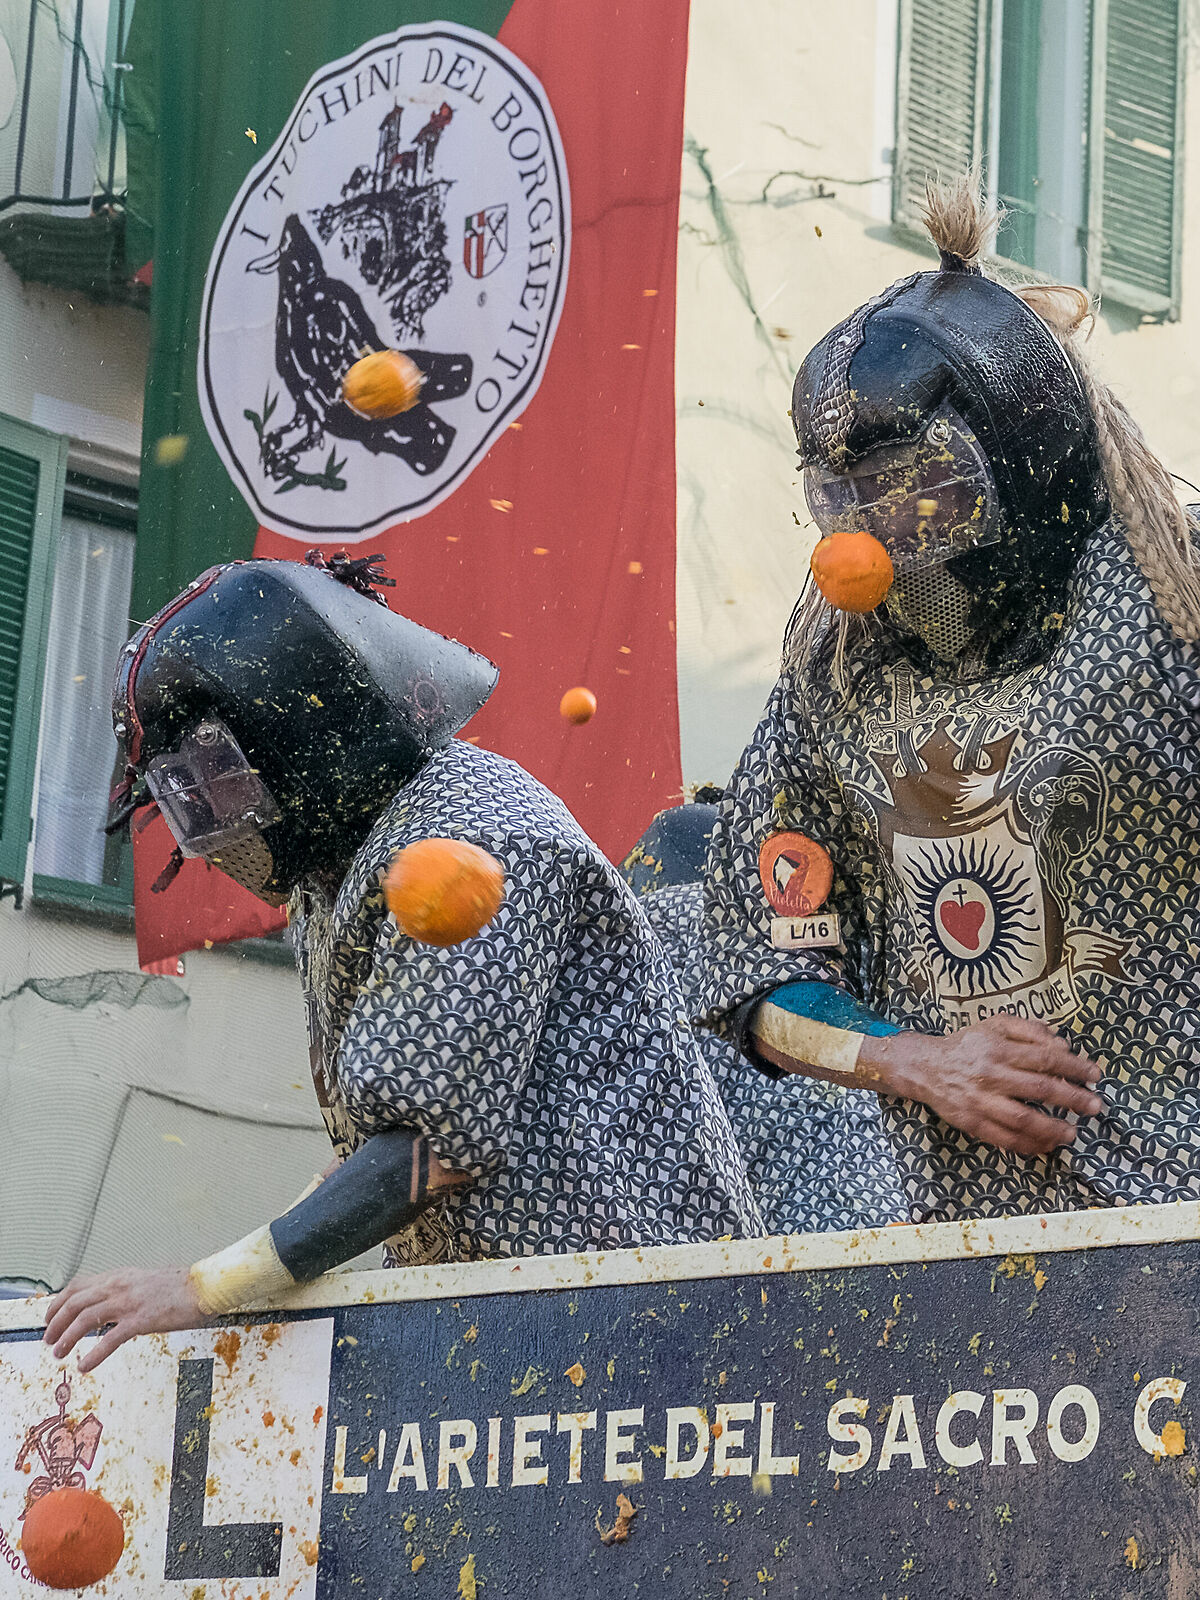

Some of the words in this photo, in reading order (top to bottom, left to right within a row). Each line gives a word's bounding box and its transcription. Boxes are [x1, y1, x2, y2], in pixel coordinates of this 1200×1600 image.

[241, 224, 270, 246] I
[263, 52, 403, 205] TUCHINI
[421, 46, 486, 105] DEL
[475, 92, 556, 413] BORGHETTO
[790, 921, 830, 940] L/16
[164, 1358, 283, 1580] L
[330, 1405, 646, 1495] L'ARIETE
[664, 1401, 800, 1482] DEL
[827, 1384, 1101, 1472] SACRO
